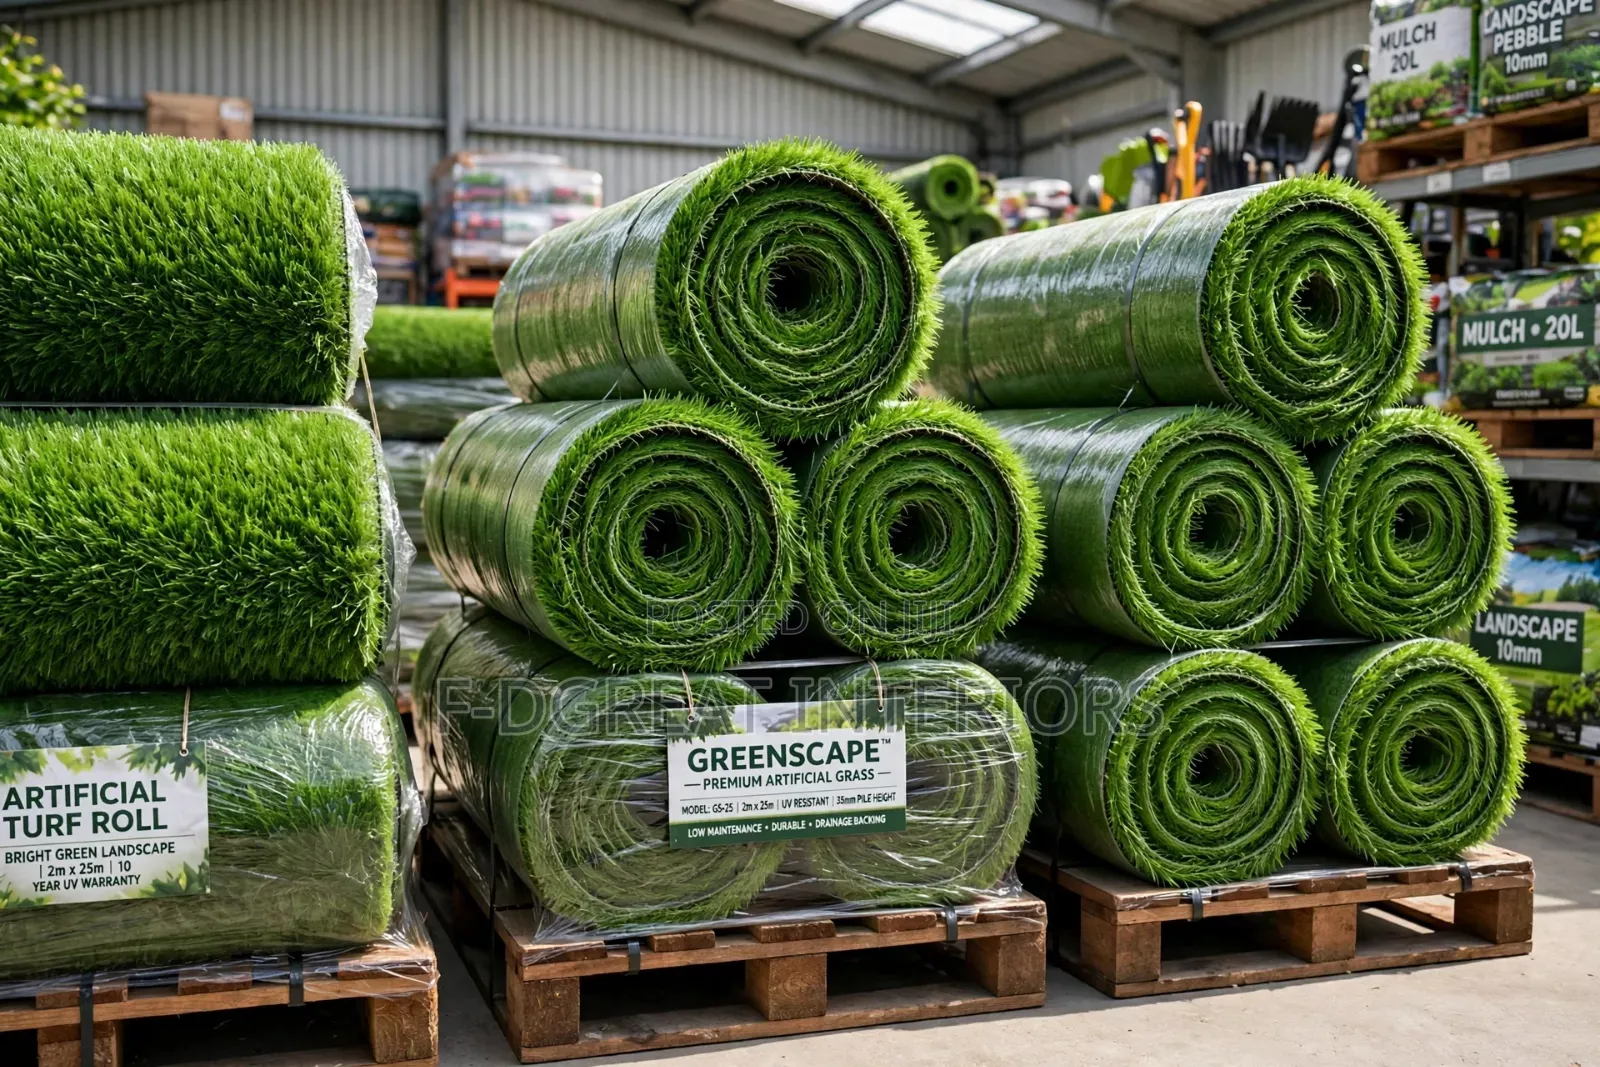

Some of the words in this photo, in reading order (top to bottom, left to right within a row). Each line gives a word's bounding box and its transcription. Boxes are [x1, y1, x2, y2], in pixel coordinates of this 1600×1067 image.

[1484, 0, 1593, 34] LANDSCAPE
[1380, 22, 1436, 52] MULCH
[1494, 20, 1563, 55] PEBBLE
[1391, 50, 1419, 74] 20L
[1505, 52, 1548, 74] 10mm
[1463, 318, 1526, 346] MULCH
[1544, 314, 1584, 341] 20L
[1475, 611, 1578, 642] LANDSCAPE
[1497, 638, 1542, 665] 10mm
[703, 775, 762, 790] PREMIUM
[766, 771, 832, 786] ARTIFICIAL
[836, 769, 875, 782] GRASS
[3, 780, 166, 810] ARTIFICIAL
[682, 805, 710, 815] MODEL:
[781, 799, 792, 809] UV
[793, 796, 829, 808] RESISTANT
[836, 794, 856, 805] 35mm
[857, 793, 872, 803] PILE
[872, 792, 896, 803] HEIGHT
[3, 812, 82, 839] TURF
[92, 807, 167, 834] ROLL
[688, 828, 704, 838] LOW
[707, 823, 762, 836] MAINTENANCE
[772, 820, 806, 832] DURABLE
[815, 817, 852, 829] DRAINAGE
[853, 814, 886, 825] BACKING
[5, 849, 52, 864] BRIGHT
[55, 846, 97, 861] GREEN
[102, 842, 175, 857] LANDSCAPE
[48, 865, 65, 877] 2m
[69, 865, 76, 875] x
[79, 862, 104, 875] 25m
[118, 860, 131, 873] 10
[33, 881, 60, 893] YEAR
[64, 878, 79, 890] UV
[81, 874, 141, 889] WARRANTY
